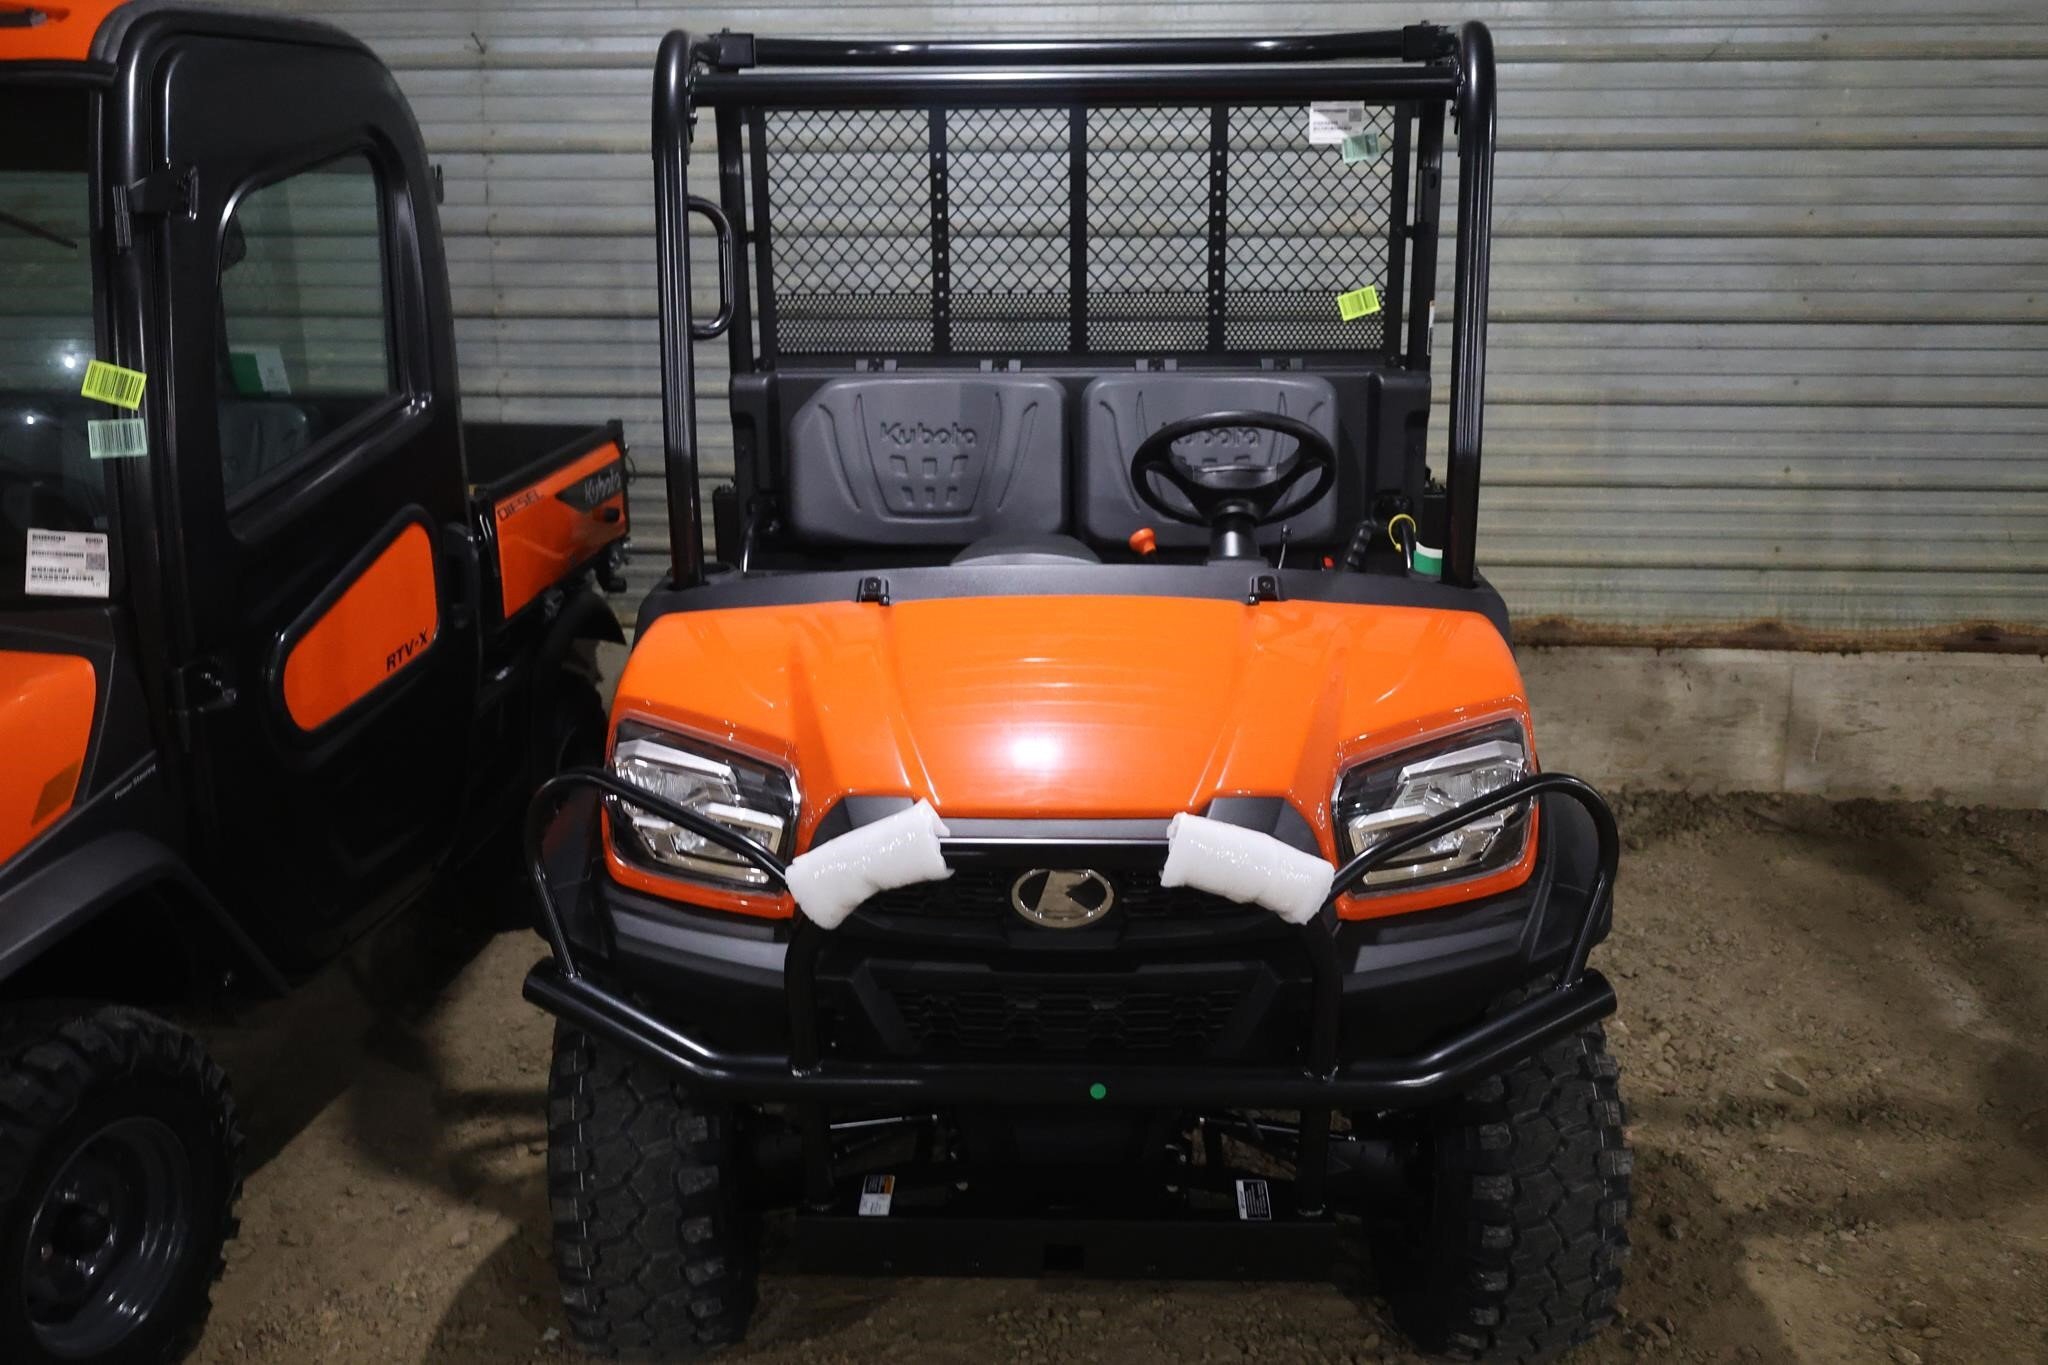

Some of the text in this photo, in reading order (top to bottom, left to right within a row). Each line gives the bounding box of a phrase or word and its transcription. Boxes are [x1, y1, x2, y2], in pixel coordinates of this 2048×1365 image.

[880, 421, 979, 447] Kubota
[1161, 421, 1261, 447] ubota
[585, 468, 622, 504] Kubota
[497, 487, 545, 523] DIESEL
[386, 627, 429, 673] RTV-X
